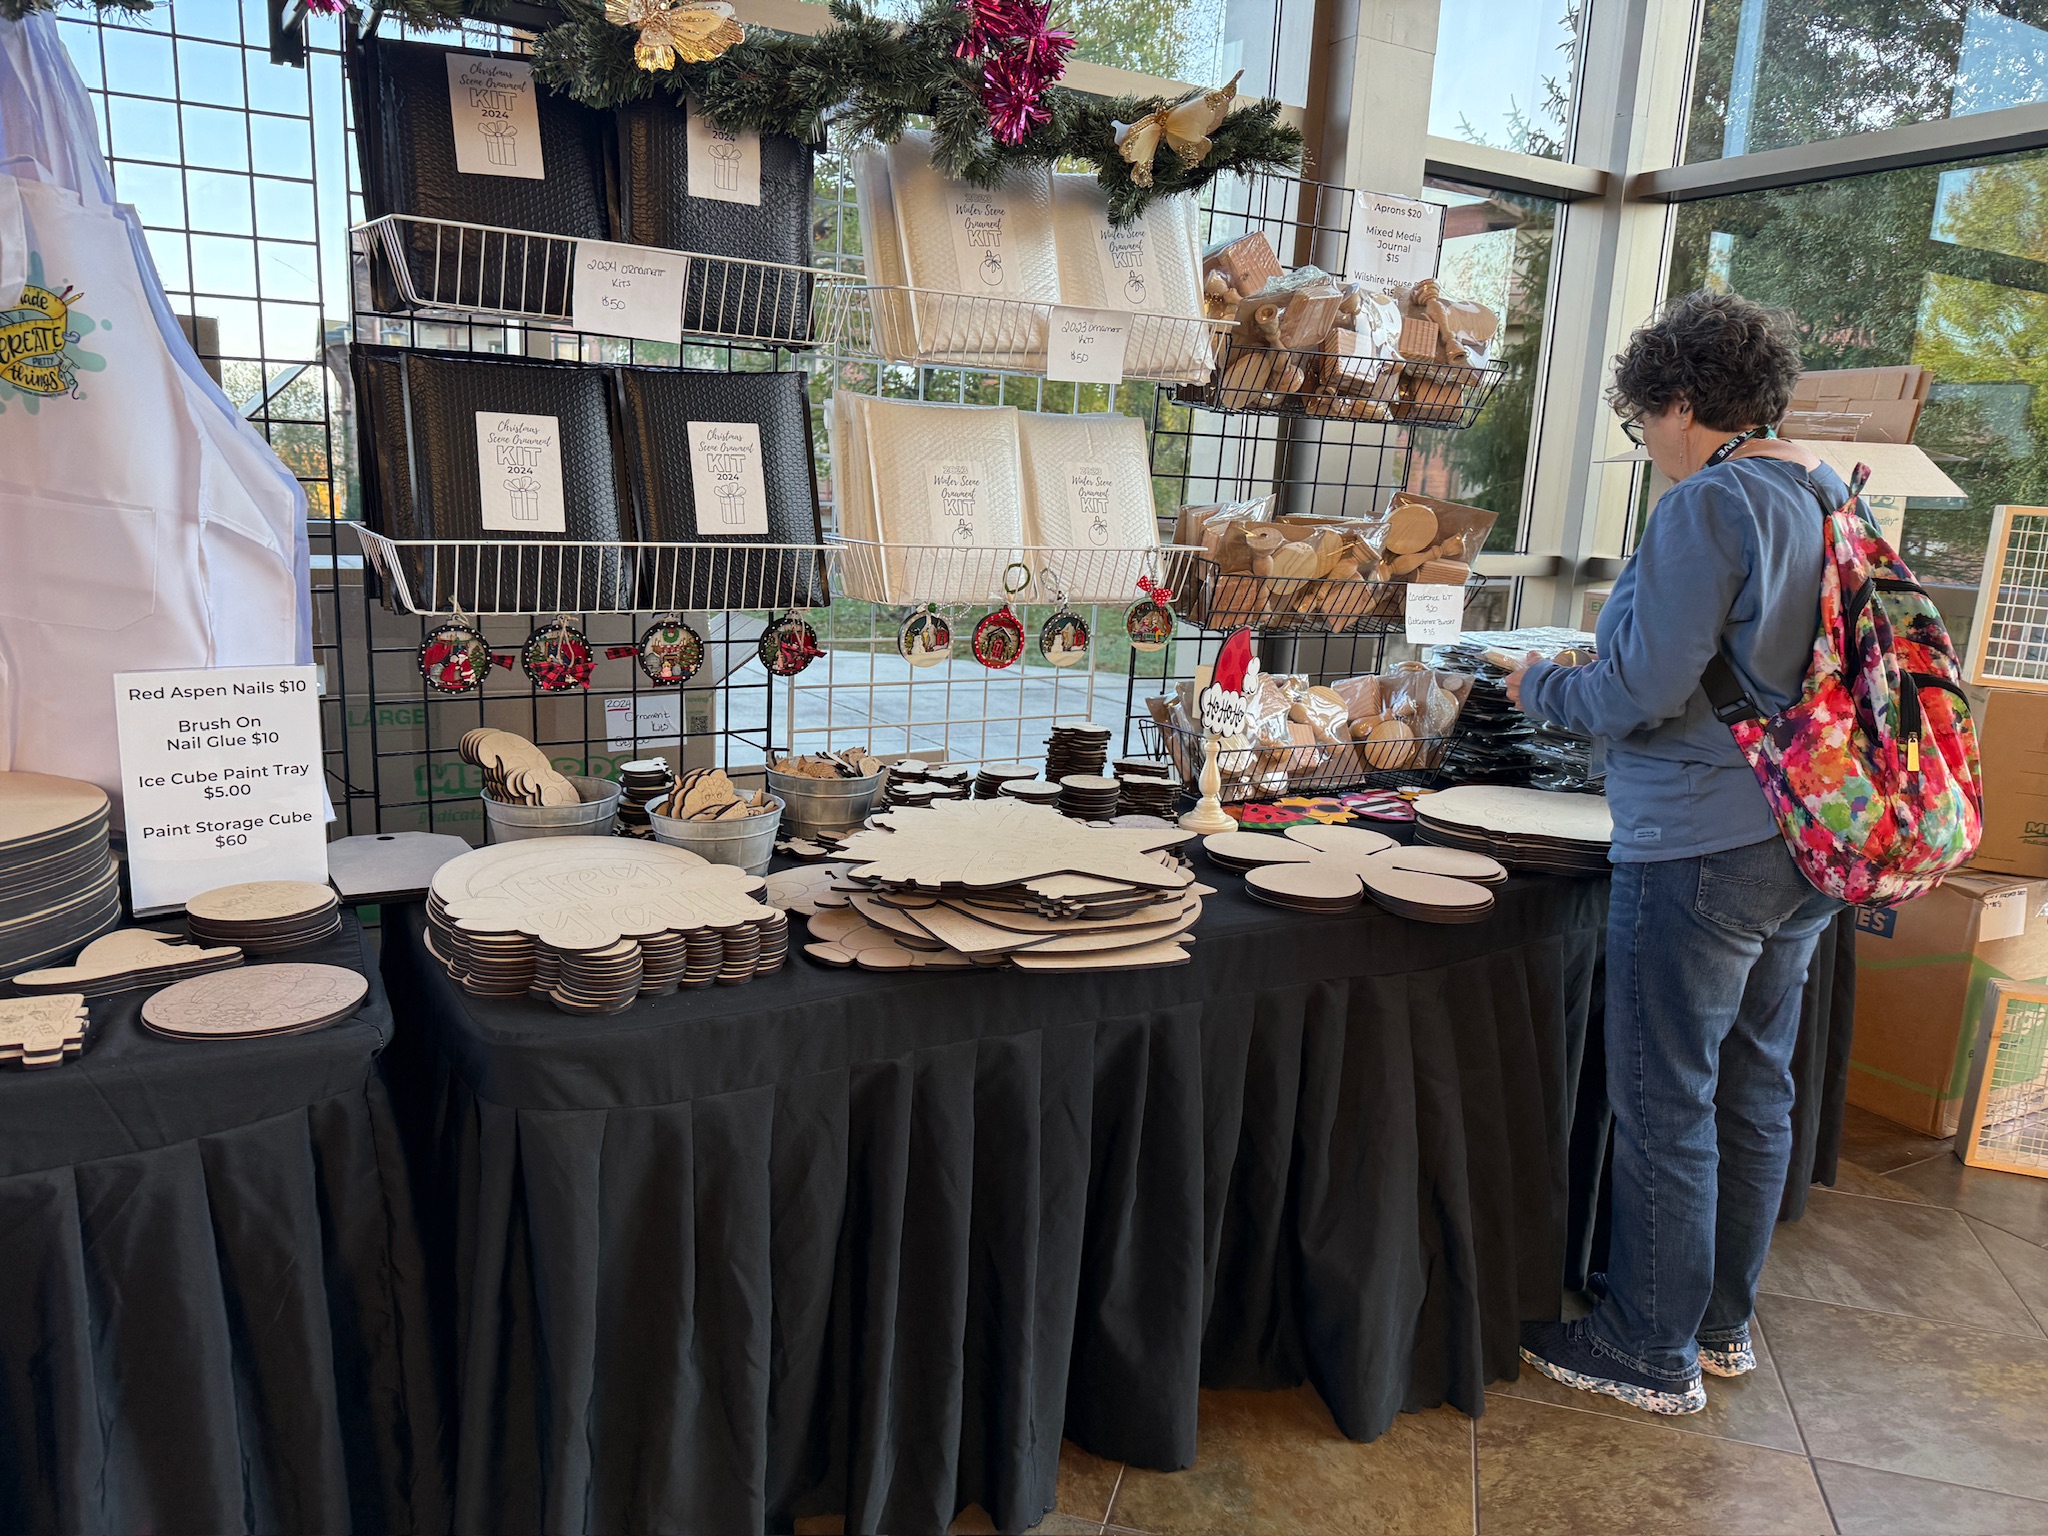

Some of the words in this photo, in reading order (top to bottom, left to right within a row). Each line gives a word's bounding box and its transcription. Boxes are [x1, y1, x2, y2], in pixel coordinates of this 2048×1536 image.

[469, 62, 514, 79] Christmas
[459, 74, 482, 86] Scene
[485, 77, 528, 93] Ornament
[469, 87, 517, 111] KIT
[481, 109, 509, 119] 2024
[712, 130, 736, 142] 2024
[956, 204, 983, 216] Winter
[984, 204, 1005, 216] Scene
[1375, 203, 1405, 216] Aprons
[1407, 208, 1422, 219] $20
[965, 217, 1002, 229] Ornament
[967, 230, 1002, 247] KIT
[1366, 226, 1394, 238] Mixed
[1396, 230, 1421, 243] Media
[1109, 240, 1143, 252] Ornament
[1377, 240, 1411, 253] Journal
[587, 259, 617, 272] 2024
[1112, 251, 1143, 268] KIT
[1386, 253, 1400, 263] $15
[1354, 270, 1385, 285] Wilshire
[1387, 277, 1412, 288] House
[1061, 321, 1087, 333] 2023
[0, 326, 62, 364] CREATE
[8, 364, 58, 391] things
[497, 418, 540, 434] Christmas
[487, 432, 510, 443] Scene
[512, 434, 552, 447] Ornament
[706, 428, 743, 442] Christmas
[698, 441, 718, 452] Scene
[720, 442, 754, 453] Ornament
[1717, 438, 1740, 458] LIVE
[496, 445, 542, 467] KIT
[707, 453, 746, 473] KIT
[507, 466, 533, 475] 2024
[717, 473, 739, 481] 2024
[934, 475, 957, 486] Winter
[960, 476, 980, 486] Scene
[1072, 476, 1094, 486] Winter
[1095, 477, 1113, 487] Scene
[941, 488, 976, 499] Ornament
[1079, 487, 1109, 498] Ornament
[943, 499, 975, 515] KIT
[1081, 497, 1109, 513] KIT
[129, 687, 165, 701] Red
[170, 685, 227, 700] Aspen
[233, 681, 275, 695] Nails
[279, 679, 307, 693] $10
[607, 699, 631, 708] 2024
[179, 717, 231, 733] Brush
[236, 716, 262, 728] On
[348, 709, 425, 726] LARGE
[167, 737, 201, 751] Nail
[207, 734, 247, 748] Glue
[251, 731, 279, 746] $10
[139, 774, 165, 788] Ice
[171, 771, 218, 785] Cube
[224, 766, 268, 781] Paint
[273, 763, 309, 776] Tray
[204, 783, 251, 800] $5.00
[143, 824, 191, 839] Paint
[196, 816, 264, 833] Storage
[269, 811, 313, 825] Cube
[215, 833, 248, 848] $60
